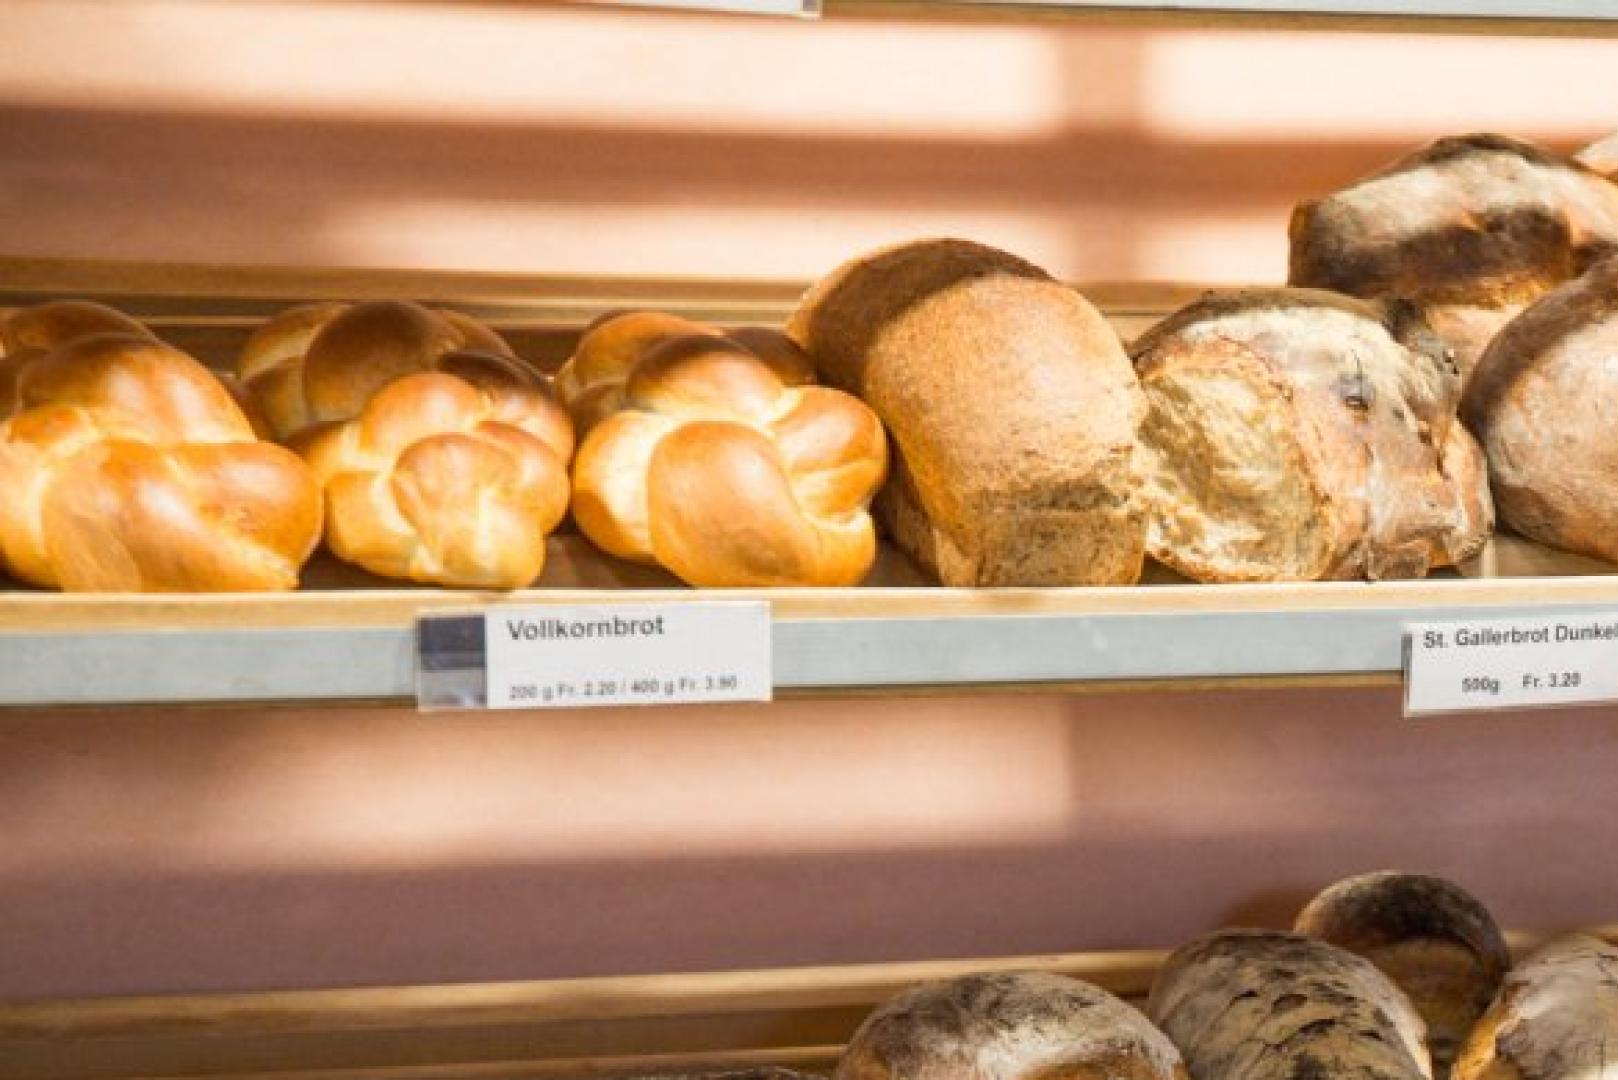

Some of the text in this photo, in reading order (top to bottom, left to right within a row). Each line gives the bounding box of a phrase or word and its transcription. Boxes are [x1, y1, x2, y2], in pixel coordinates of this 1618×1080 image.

[506, 615, 664, 640] Vollkornbrot
[1423, 631, 1448, 649] St.
[1456, 627, 1549, 646] Gallerbrot
